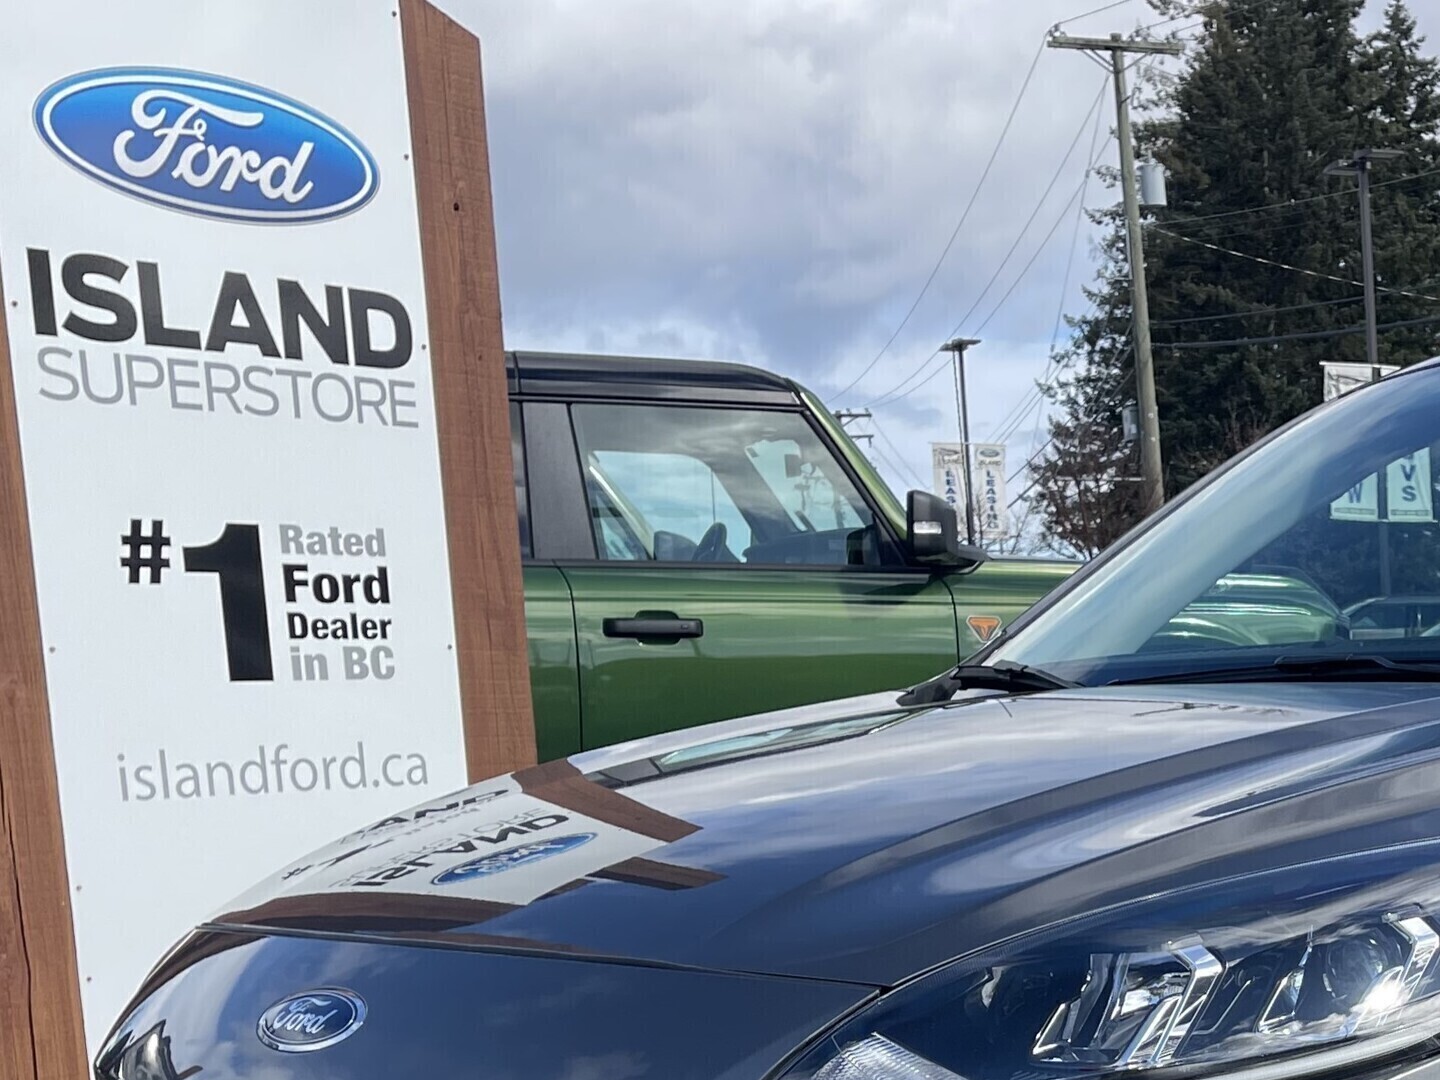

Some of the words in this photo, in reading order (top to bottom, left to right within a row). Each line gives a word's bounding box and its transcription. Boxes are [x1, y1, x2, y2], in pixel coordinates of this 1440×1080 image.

[113, 89, 314, 203] Ford
[26, 247, 413, 369] ISLAND
[37, 347, 419, 428] SUPERSTORE
[279, 524, 387, 558] Rated
[120, 519, 274, 682] #1
[282, 563, 391, 605] Ford
[286, 612, 392, 641] Dealer
[290, 646, 329, 682] in
[343, 646, 396, 682] BC
[116, 742, 429, 802] islandford.ca
[272, 996, 339, 1034] Ford
